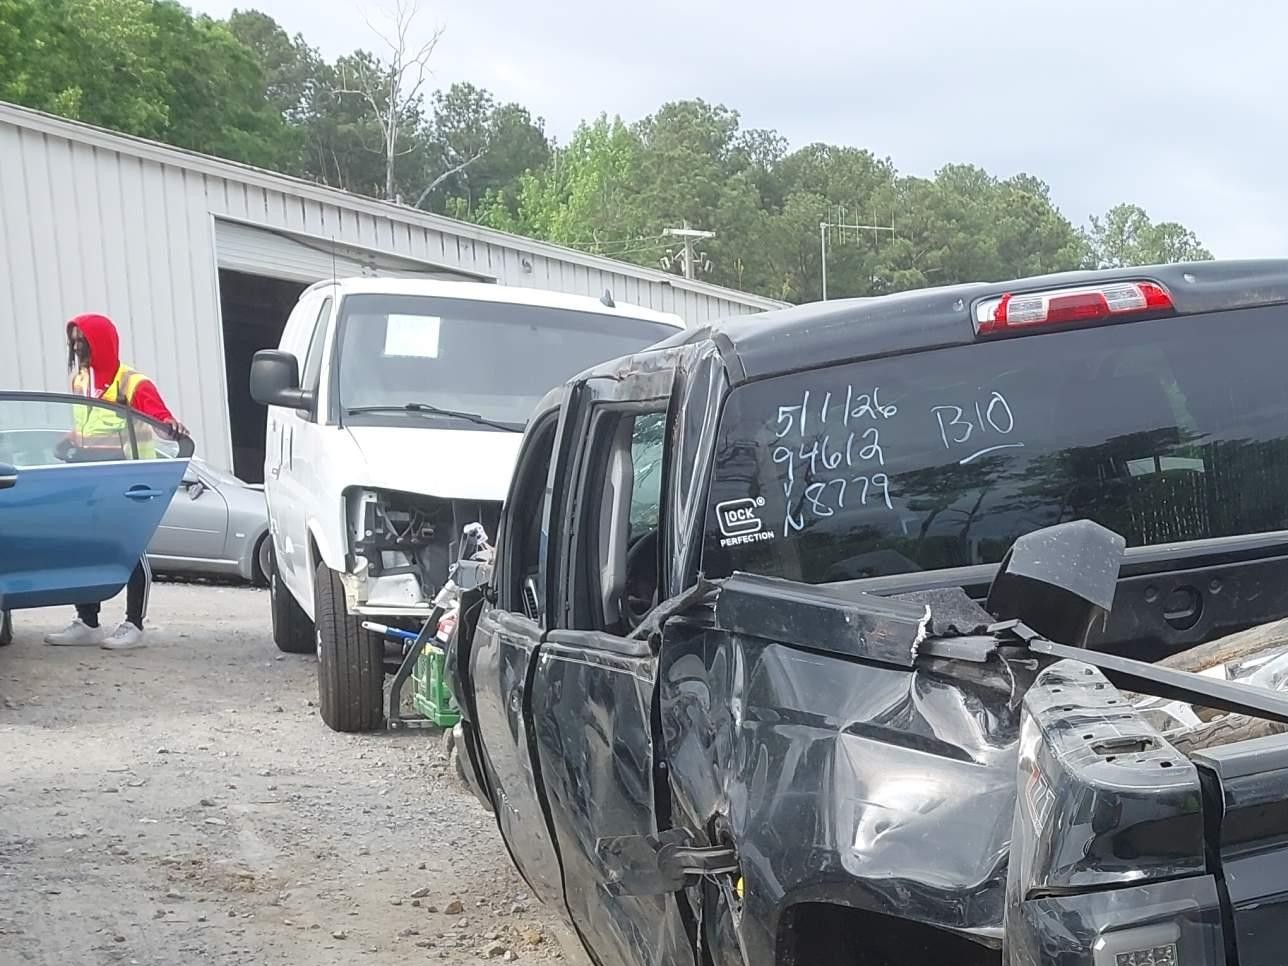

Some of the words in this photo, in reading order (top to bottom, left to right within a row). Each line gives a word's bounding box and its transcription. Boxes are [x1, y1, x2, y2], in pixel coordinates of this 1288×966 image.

[775, 385, 898, 437] 5/1/26
[930, 391, 1015, 449] B10
[773, 427, 885, 481] 94612
[719, 530, 775, 548] PERFECTION
